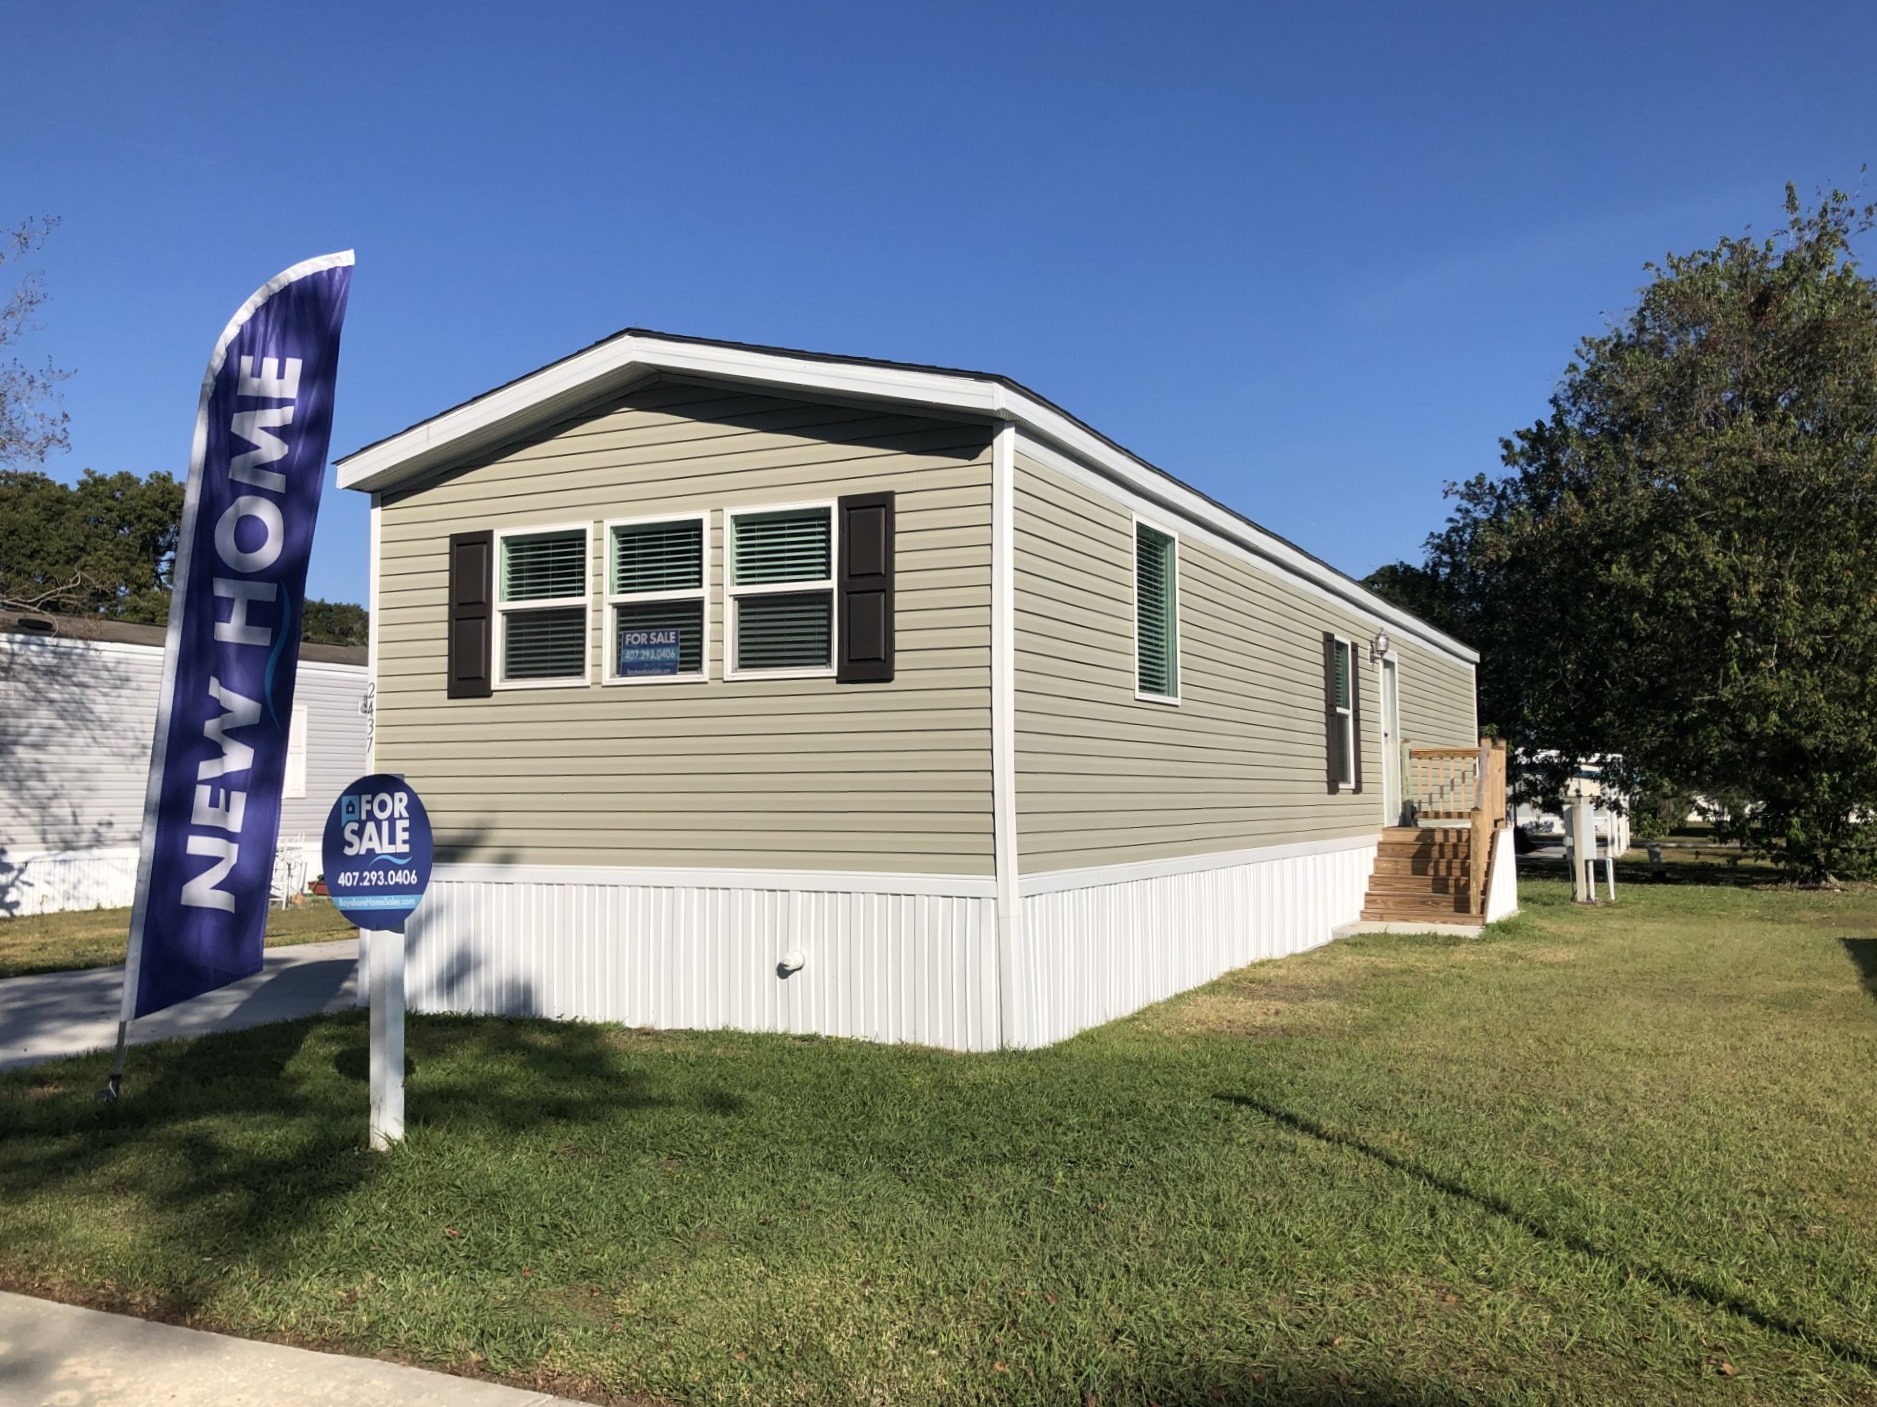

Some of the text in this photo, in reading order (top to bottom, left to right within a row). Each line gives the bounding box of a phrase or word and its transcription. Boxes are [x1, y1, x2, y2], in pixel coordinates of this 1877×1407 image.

[181, 354, 302, 913] NEW HOME
[625, 631, 676, 645] FOR SALE
[624, 649, 676, 660] 407.293.0406
[366, 682, 375, 753] 2437
[360, 791, 408, 820] FOR
[343, 819, 410, 856] SALE
[338, 870, 418, 886] 407.293.0406
